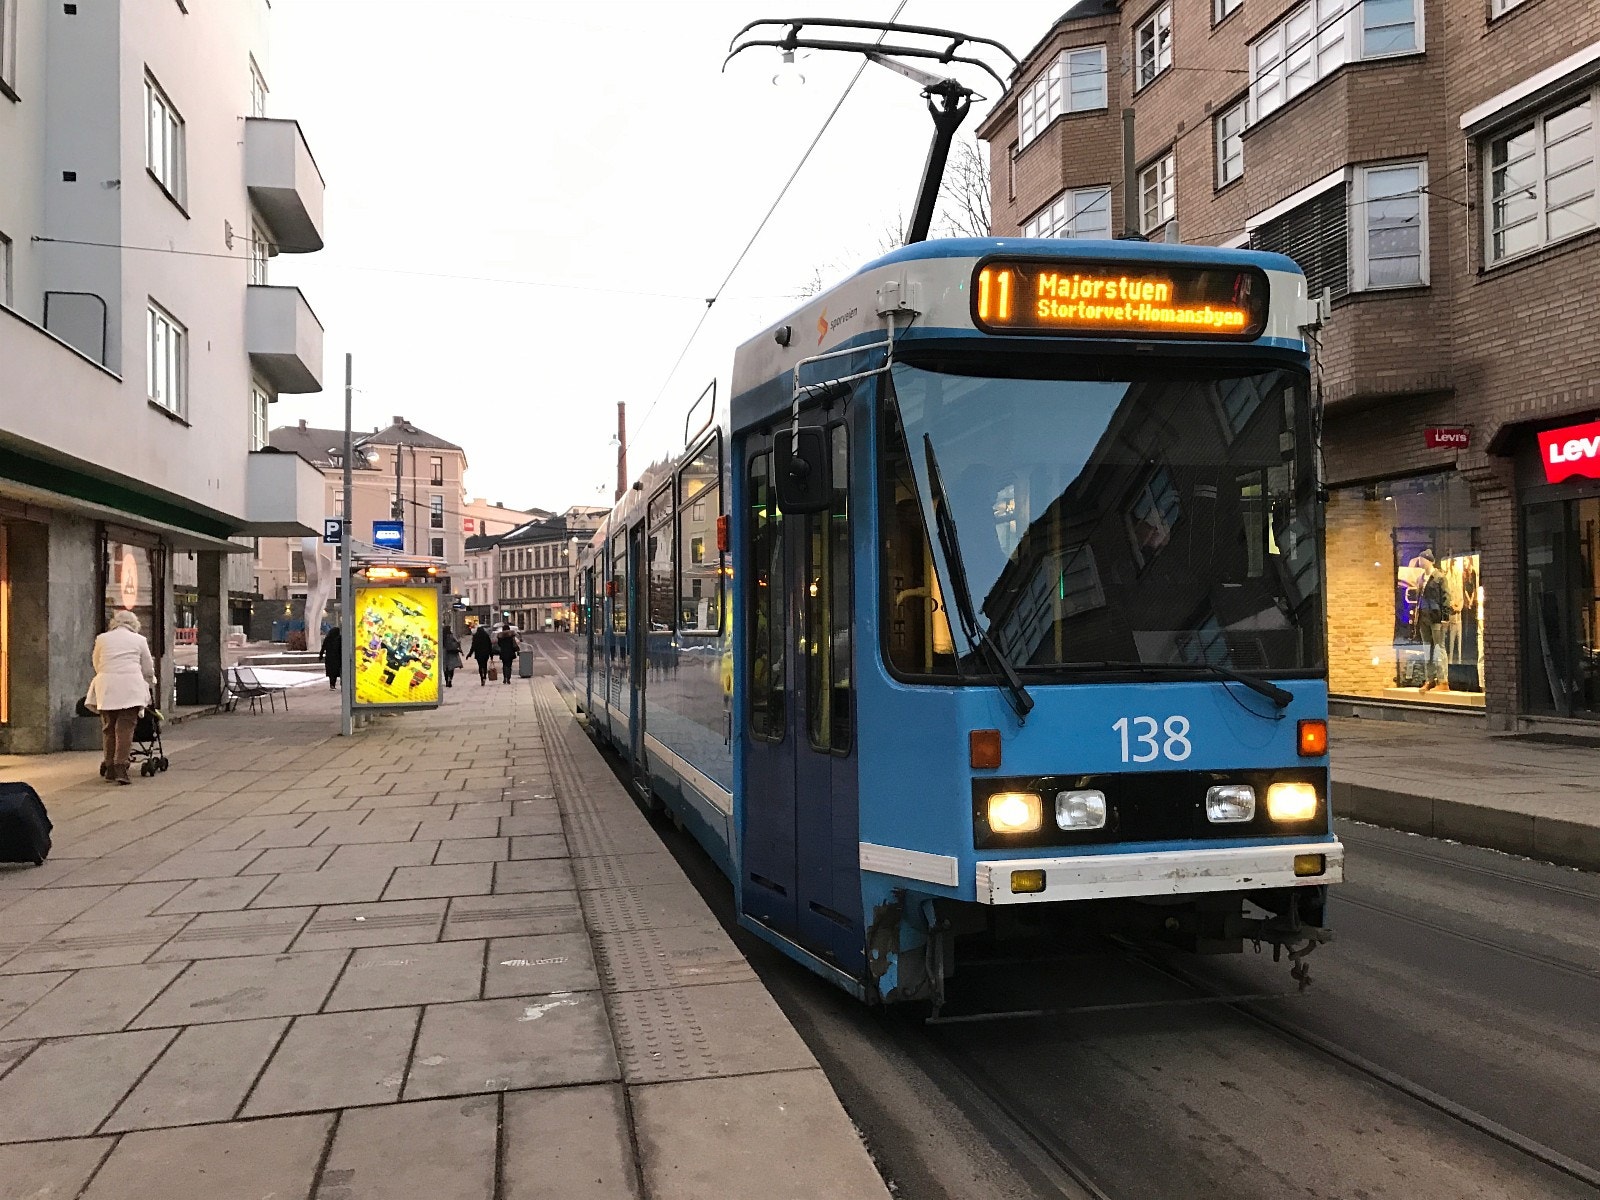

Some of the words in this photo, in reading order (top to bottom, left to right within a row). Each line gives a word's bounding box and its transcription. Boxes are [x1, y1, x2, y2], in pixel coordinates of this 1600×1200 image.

[978, 269, 1010, 317] 11
[1038, 273, 1168, 301] Majorstuen
[1038, 300, 1245, 325] Stortorvet-Homansbyen
[326, 521, 340, 535] P
[1111, 715, 1192, 763] 138
